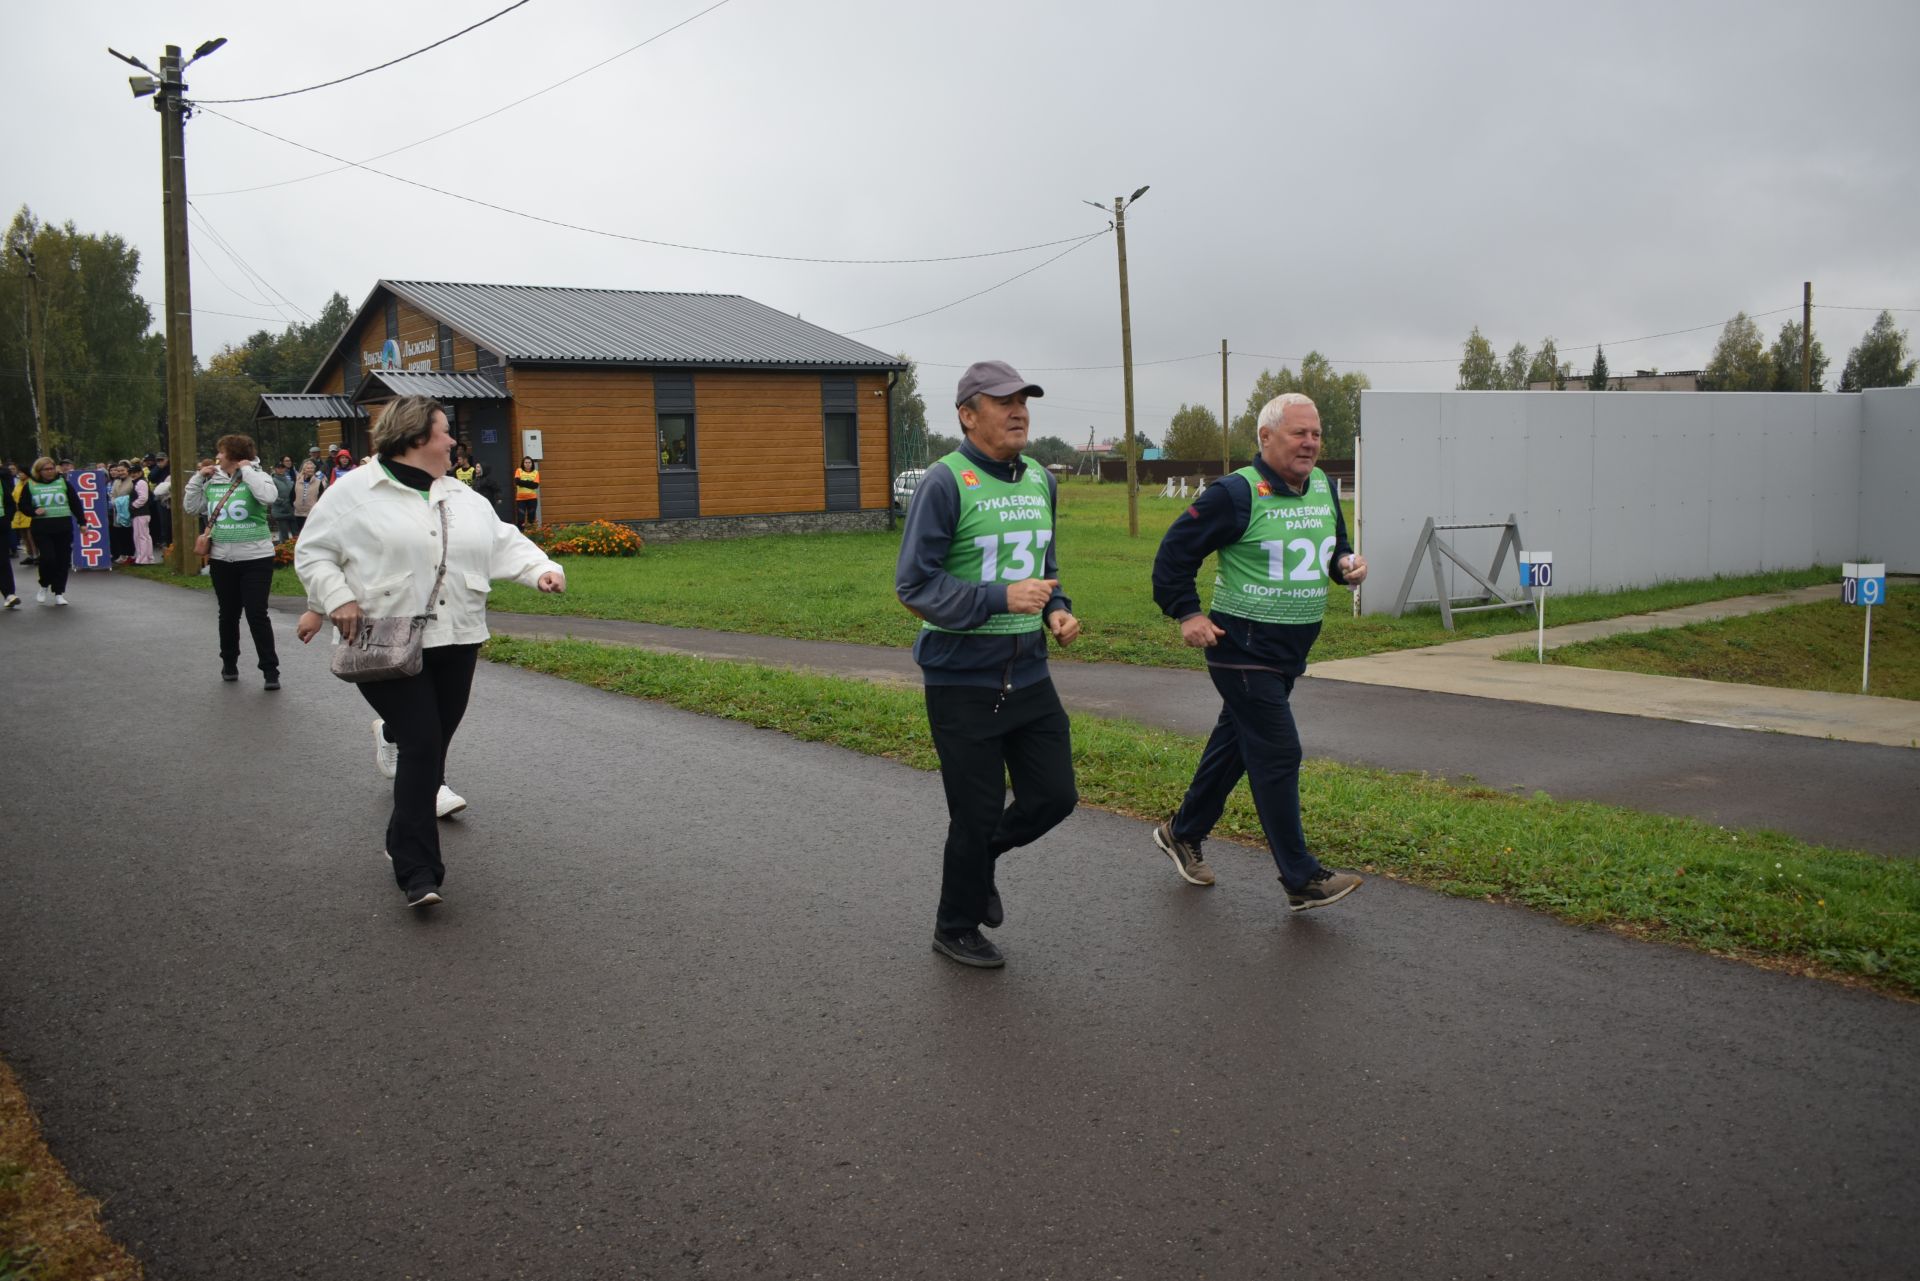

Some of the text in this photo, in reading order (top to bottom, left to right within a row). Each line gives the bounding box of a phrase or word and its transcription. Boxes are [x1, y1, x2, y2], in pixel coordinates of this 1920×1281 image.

[402, 334, 436, 358] Лыжный
[32, 491, 66, 507] 170
[976, 494, 1047, 513] ТУКАЕВСКИЙ
[77, 472, 103, 567] СТАРТ
[999, 507, 1043, 523] РАЙОН
[1265, 504, 1332, 520] ТУКАЕВСКИЙ
[1285, 517, 1324, 531] РАЙОН
[974, 529, 1053, 582] 137
[1259, 535, 1337, 582] 126
[1531, 563, 1551, 586] 10
[1842, 577, 1857, 604] 10
[1863, 578, 1879, 605] 9
